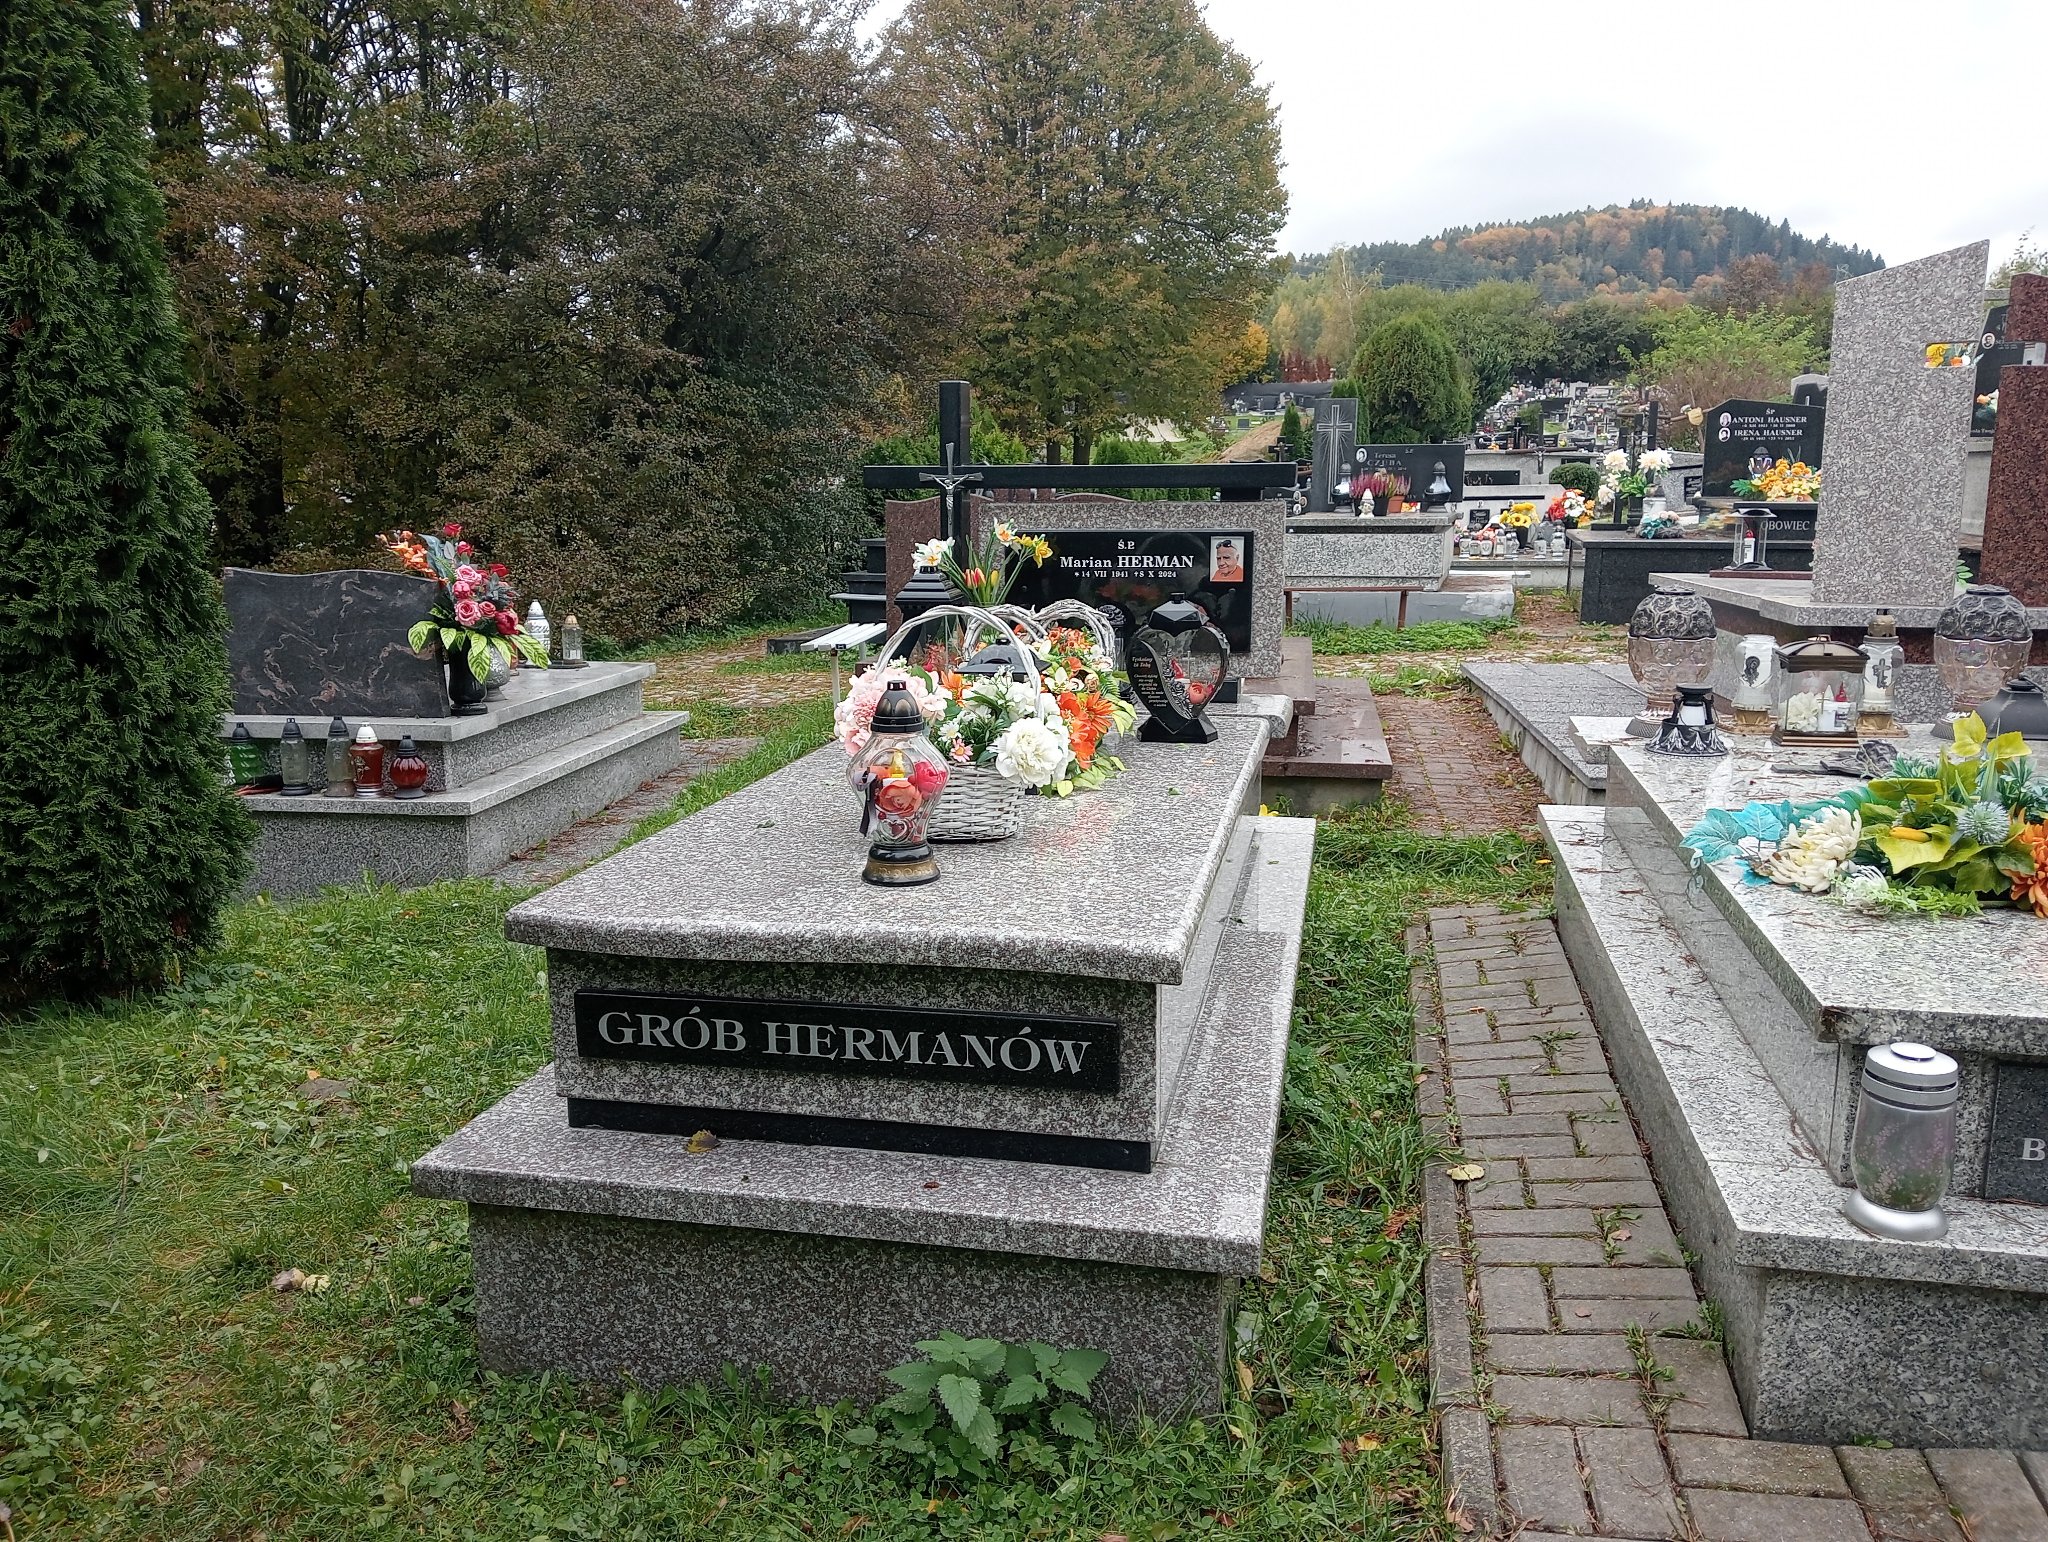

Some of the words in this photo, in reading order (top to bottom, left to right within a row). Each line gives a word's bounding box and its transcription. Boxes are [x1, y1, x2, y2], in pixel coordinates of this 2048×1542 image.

[1732, 416, 1764, 424] ANTONI
[1760, 520, 1810, 531] OBOWIEC
[1060, 556, 1113, 568] Marian
[1116, 555, 1195, 568] HERMAN
[1094, 570, 1107, 578] VII
[1111, 570, 1129, 578] 1941
[1148, 570, 1155, 578] X
[1158, 570, 1177, 578] 2024
[598, 1006, 747, 1053] GRÓB
[761, 1020, 1092, 1076] HERMANÓW
